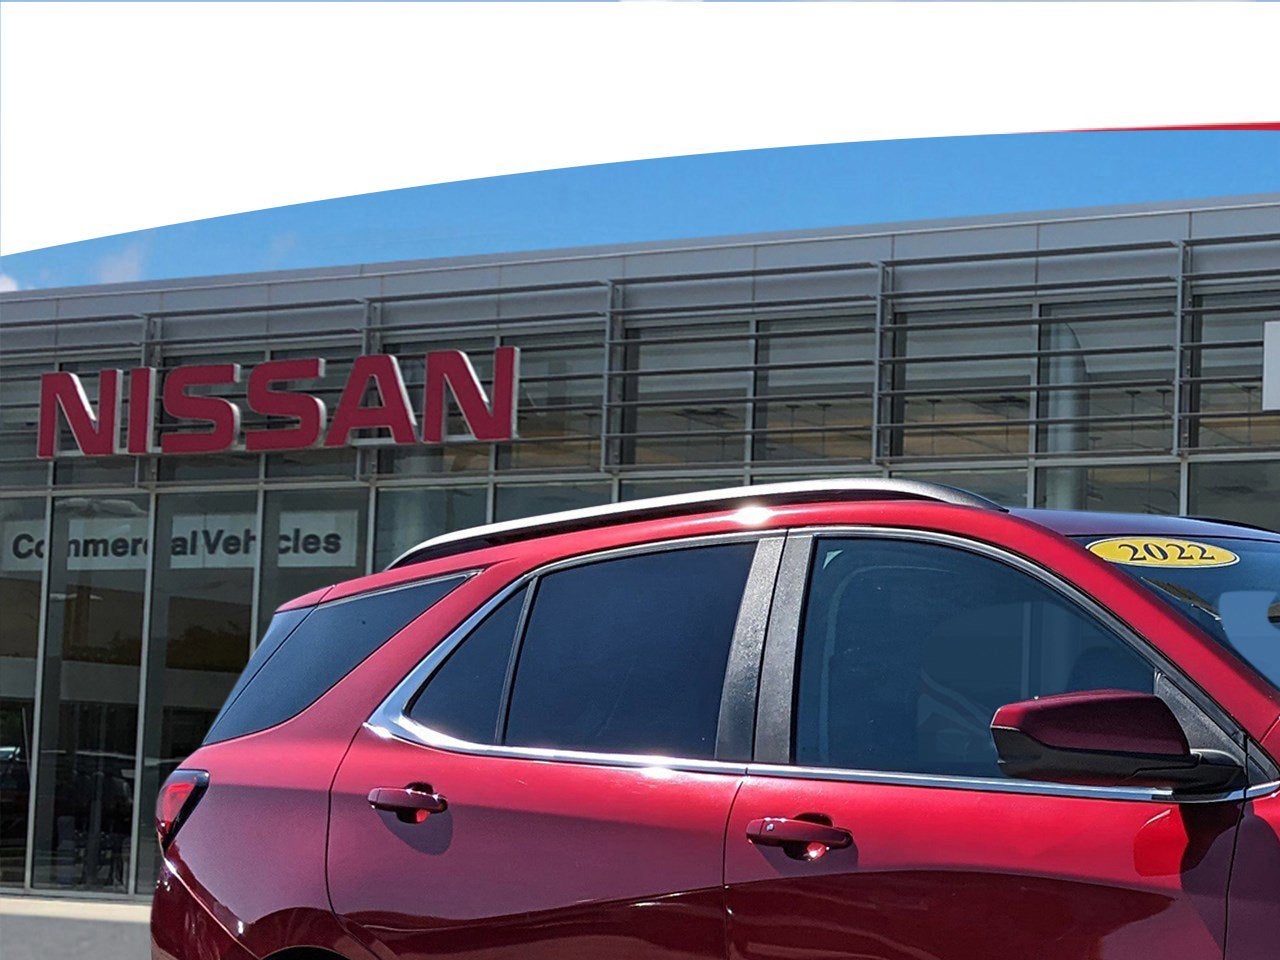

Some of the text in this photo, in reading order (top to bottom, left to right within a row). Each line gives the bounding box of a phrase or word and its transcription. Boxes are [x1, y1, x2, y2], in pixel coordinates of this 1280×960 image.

[37, 346, 519, 458] NISSAN
[12, 527, 342, 560] Commeral Vehcles
[1118, 543, 1216, 562] 2022
